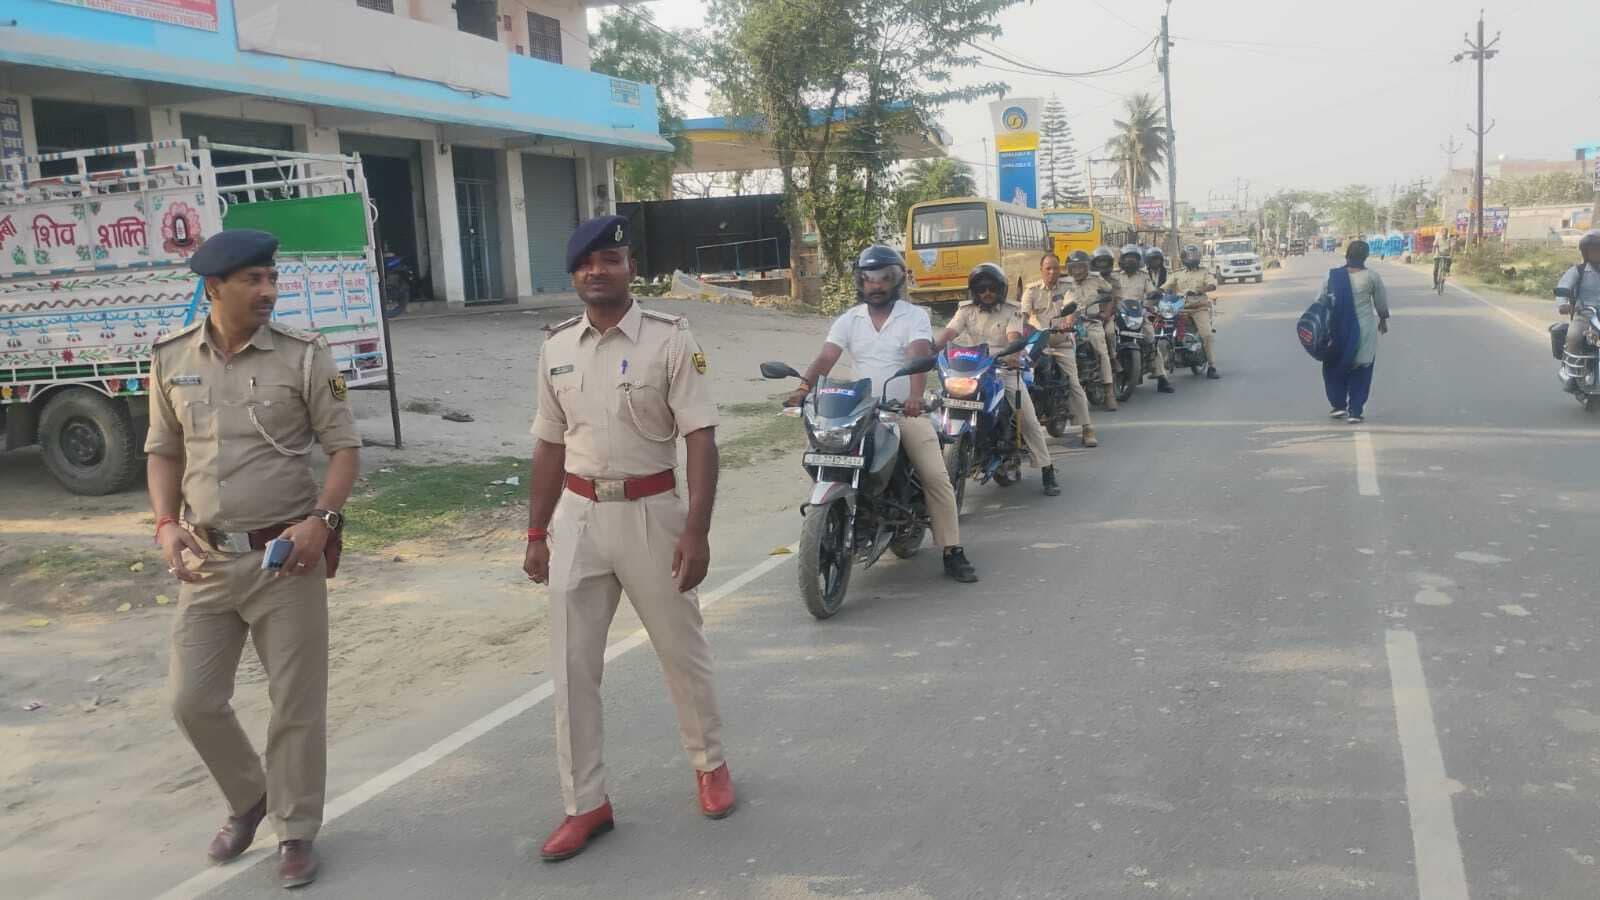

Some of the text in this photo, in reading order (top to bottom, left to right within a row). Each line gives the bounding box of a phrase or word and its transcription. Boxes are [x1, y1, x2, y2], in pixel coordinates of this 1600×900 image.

[32, 214, 77, 248] शिव
[97, 216, 147, 249] शक्ति
[818, 387, 857, 396] POLICE
